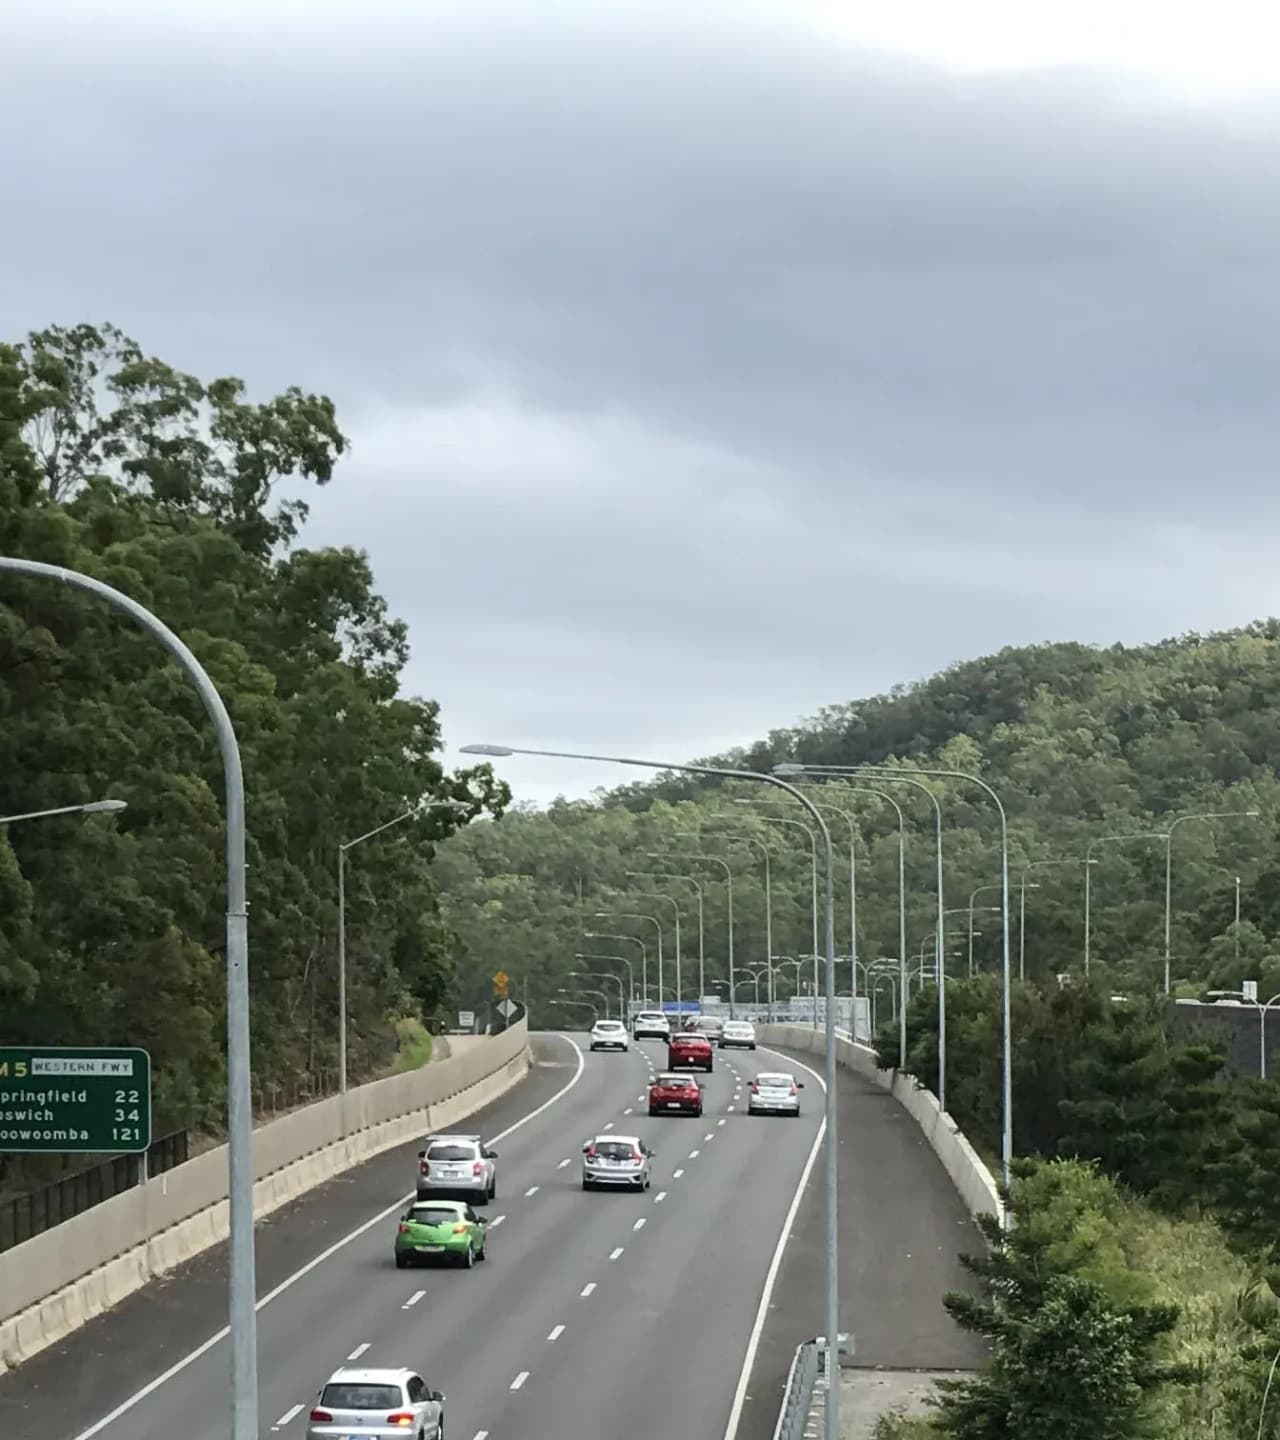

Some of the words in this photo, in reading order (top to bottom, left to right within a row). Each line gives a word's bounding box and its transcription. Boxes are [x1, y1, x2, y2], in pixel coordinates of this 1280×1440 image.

[34, 1062, 95, 1072] WESTERN
[101, 1063, 130, 1073] FWY
[0, 1089, 87, 1106] pringfield
[115, 1090, 140, 1103] 22
[0, 1109, 54, 1121] swich
[114, 1109, 140, 1122] 34
[0, 1127, 89, 1140] oowoomba
[112, 1128, 141, 1141] 121
